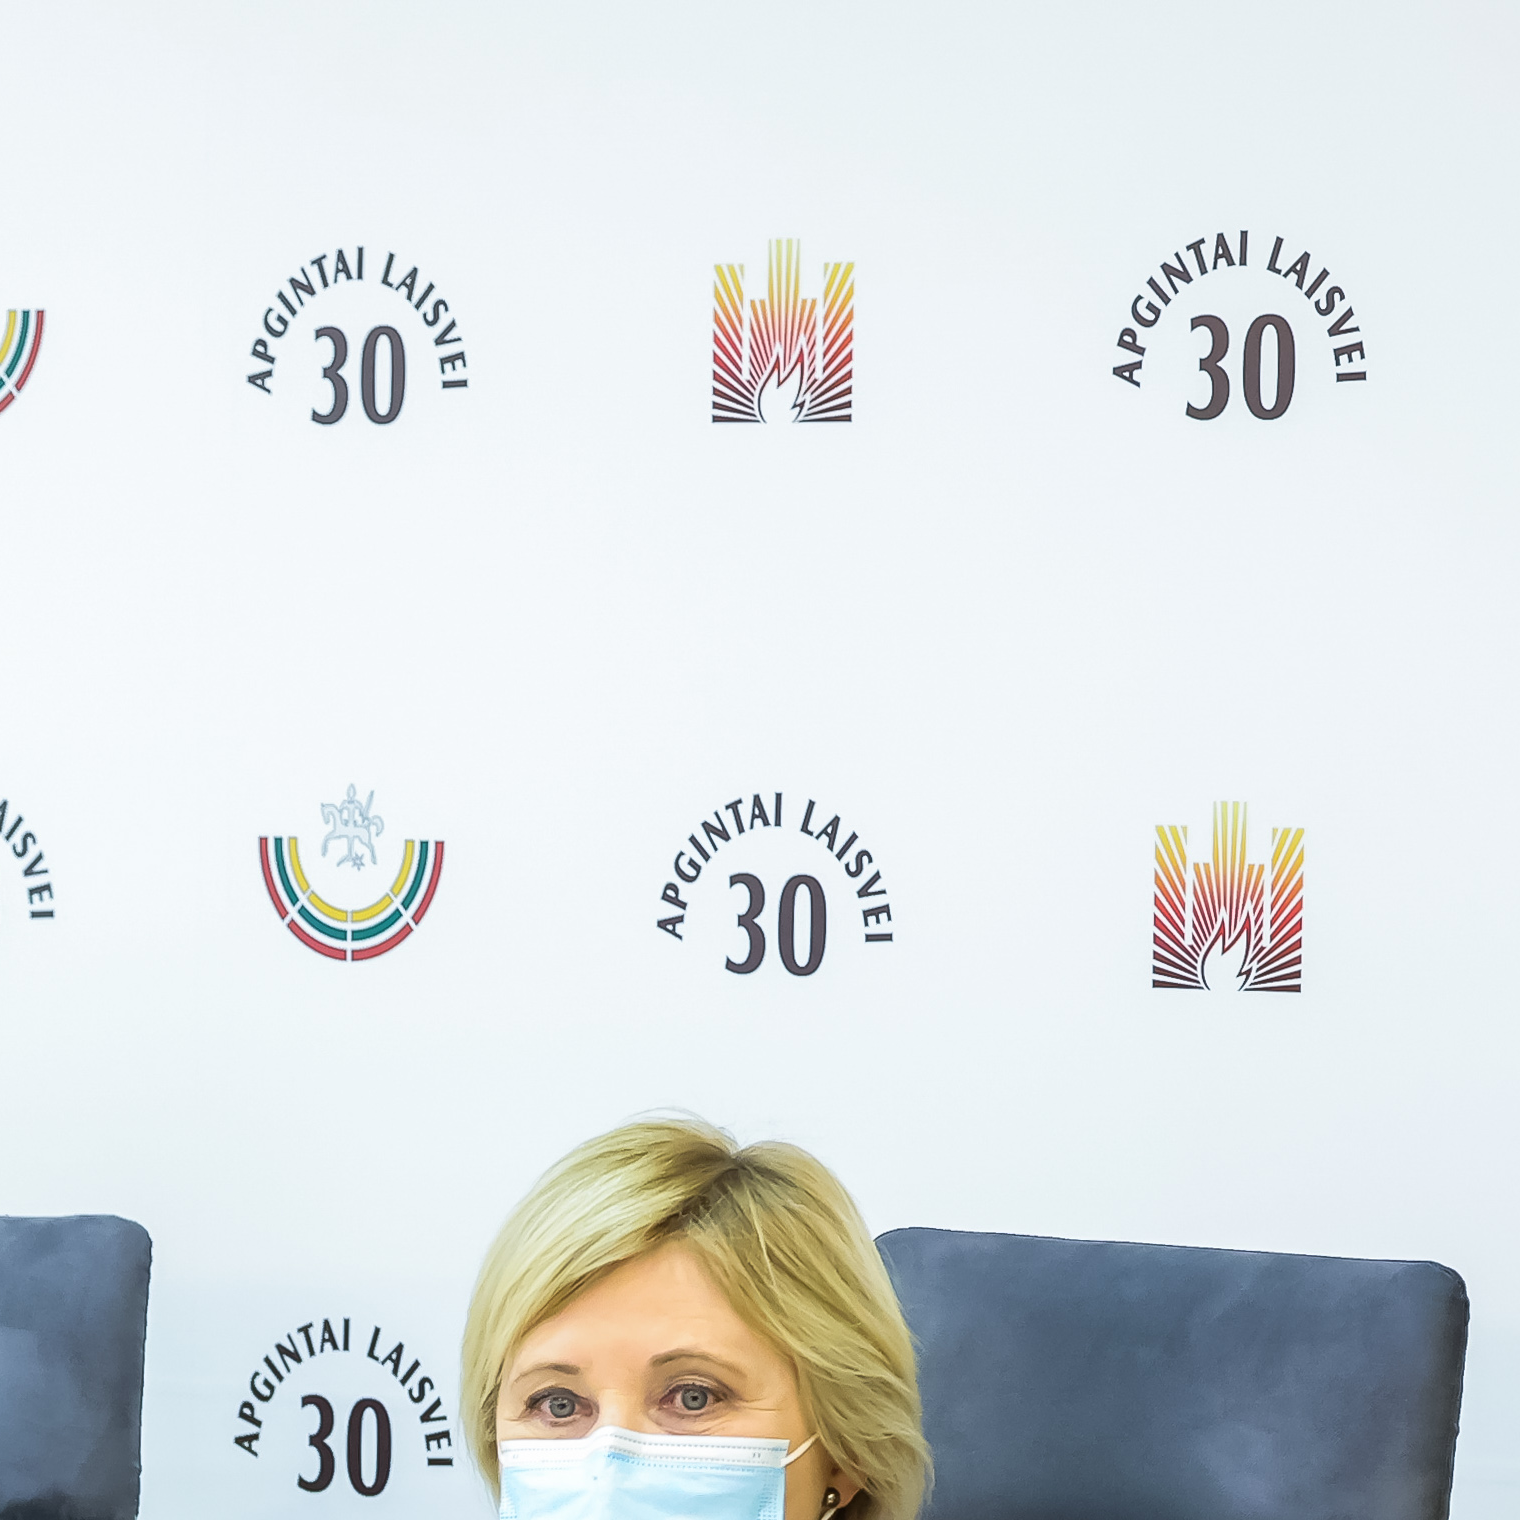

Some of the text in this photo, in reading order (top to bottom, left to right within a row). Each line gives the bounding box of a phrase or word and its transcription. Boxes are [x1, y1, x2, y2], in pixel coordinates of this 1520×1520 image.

[246, 245, 469, 395] APGINTAI LAISVEI
[1111, 229, 1368, 389] APGINTAI LAISVEI
[1184, 313, 1296, 422] 30
[310, 324, 407, 426] 30
[656, 791, 894, 943] APGINTAI LAISVEI
[724, 872, 828, 978] 30
[232, 1316, 455, 1468] APGINTAI LAISVEI
[296, 1393, 393, 1498] 30
